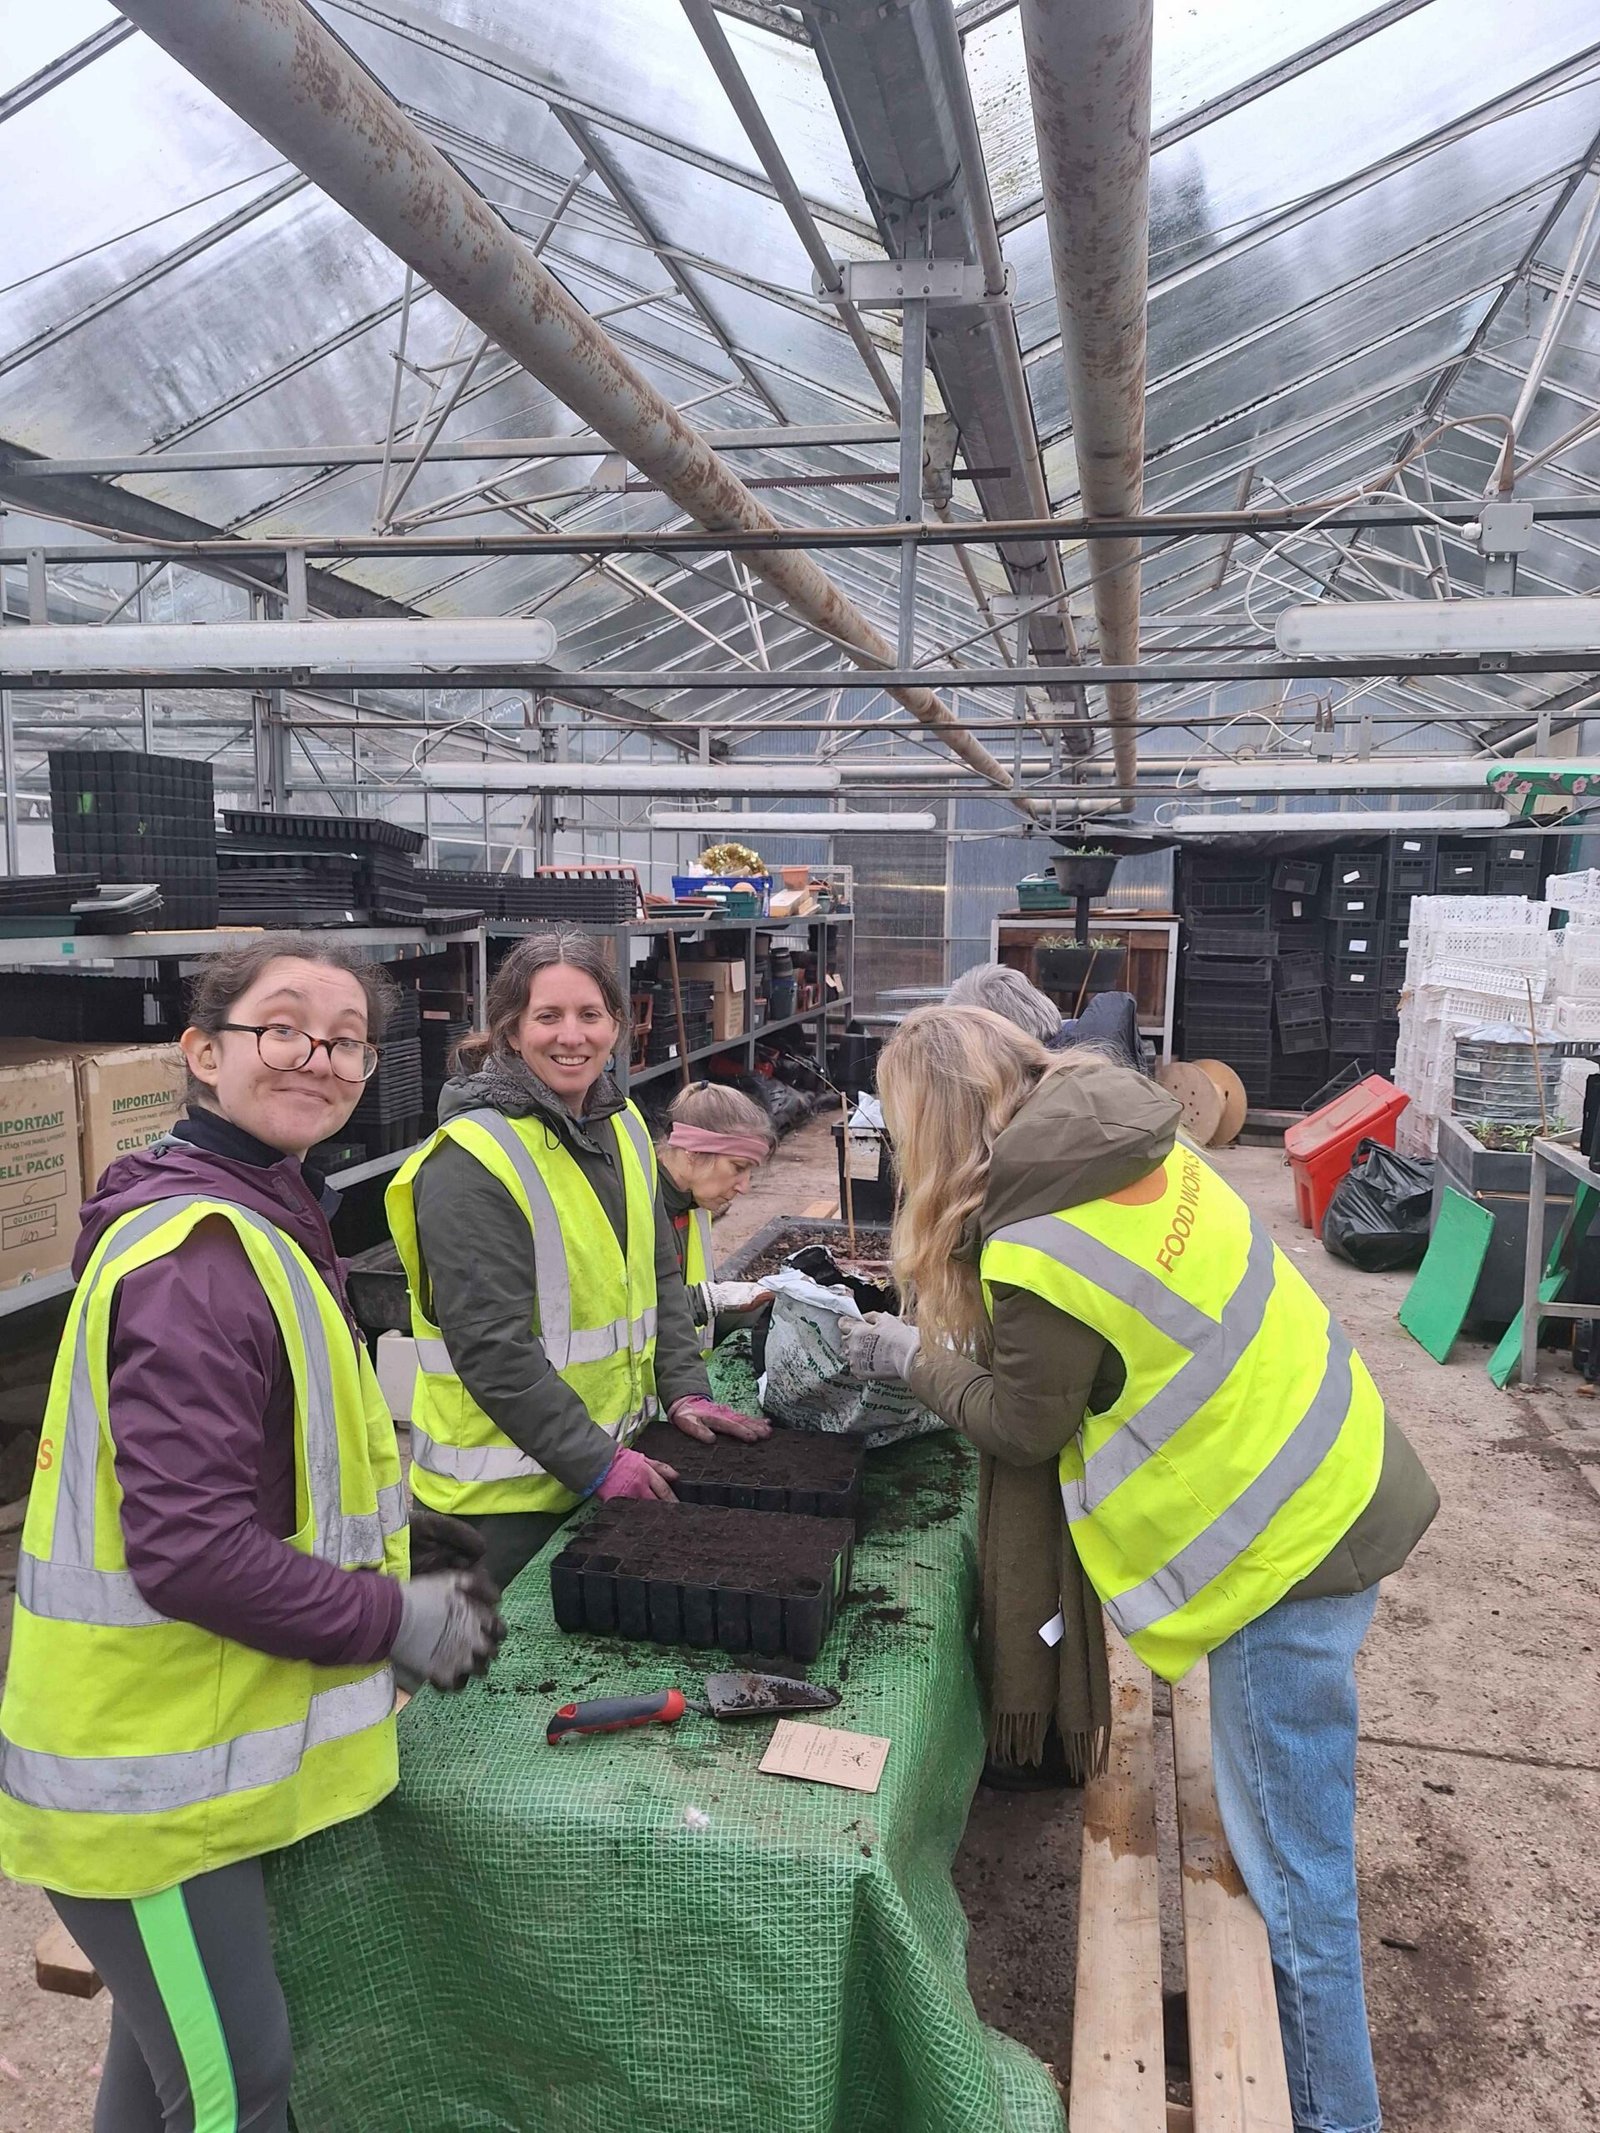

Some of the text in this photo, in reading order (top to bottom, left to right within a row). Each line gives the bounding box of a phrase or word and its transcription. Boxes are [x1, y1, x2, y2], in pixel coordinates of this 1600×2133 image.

[112, 1089, 177, 1112] IMPORTANT
[116, 1129, 172, 1151] CELL PAC
[0, 1153, 65, 1180] ELL PACKS
[23, 1182, 38, 1206] 6
[13, 1209, 48, 1225] QUANTITY
